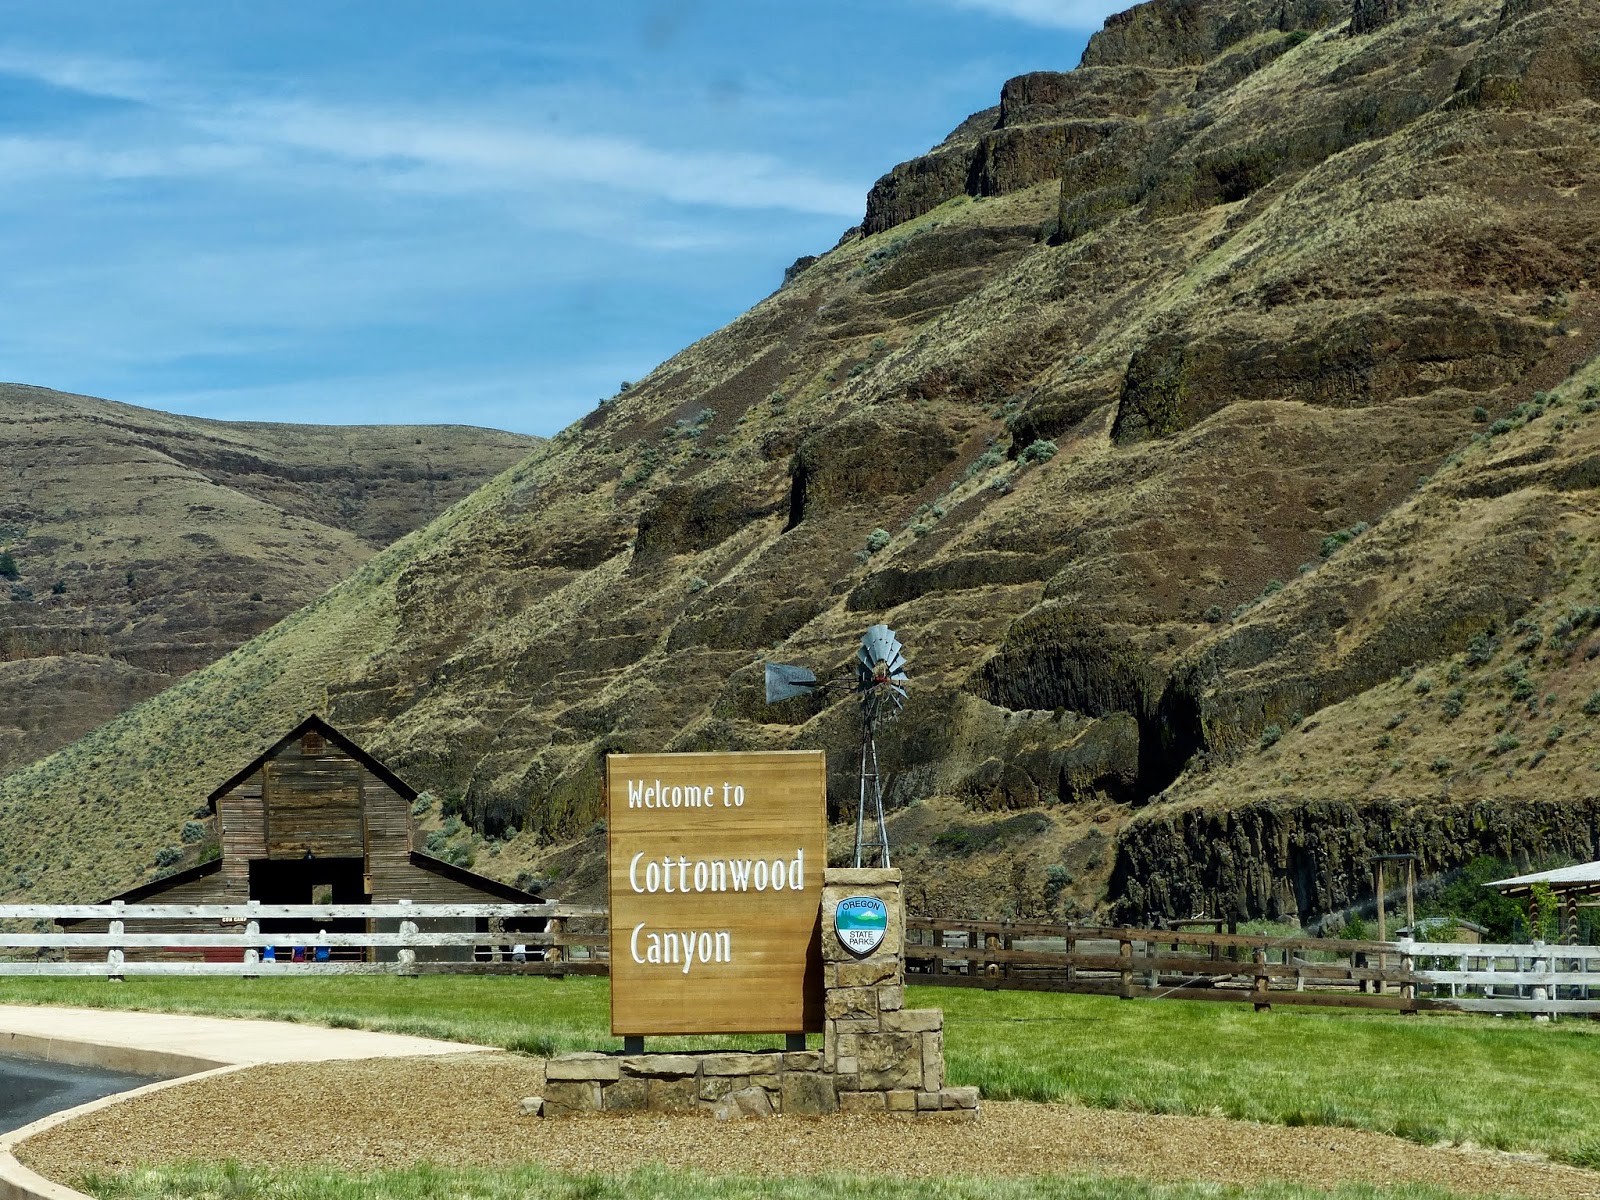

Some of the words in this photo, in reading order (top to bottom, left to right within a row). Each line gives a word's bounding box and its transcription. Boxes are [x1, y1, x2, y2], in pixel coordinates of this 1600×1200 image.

[628, 779, 714, 808] Welcome
[722, 781, 745, 808] to
[629, 847, 804, 894] Cottonwood
[842, 900, 880, 910] OREGON
[630, 922, 731, 974] Canyon
